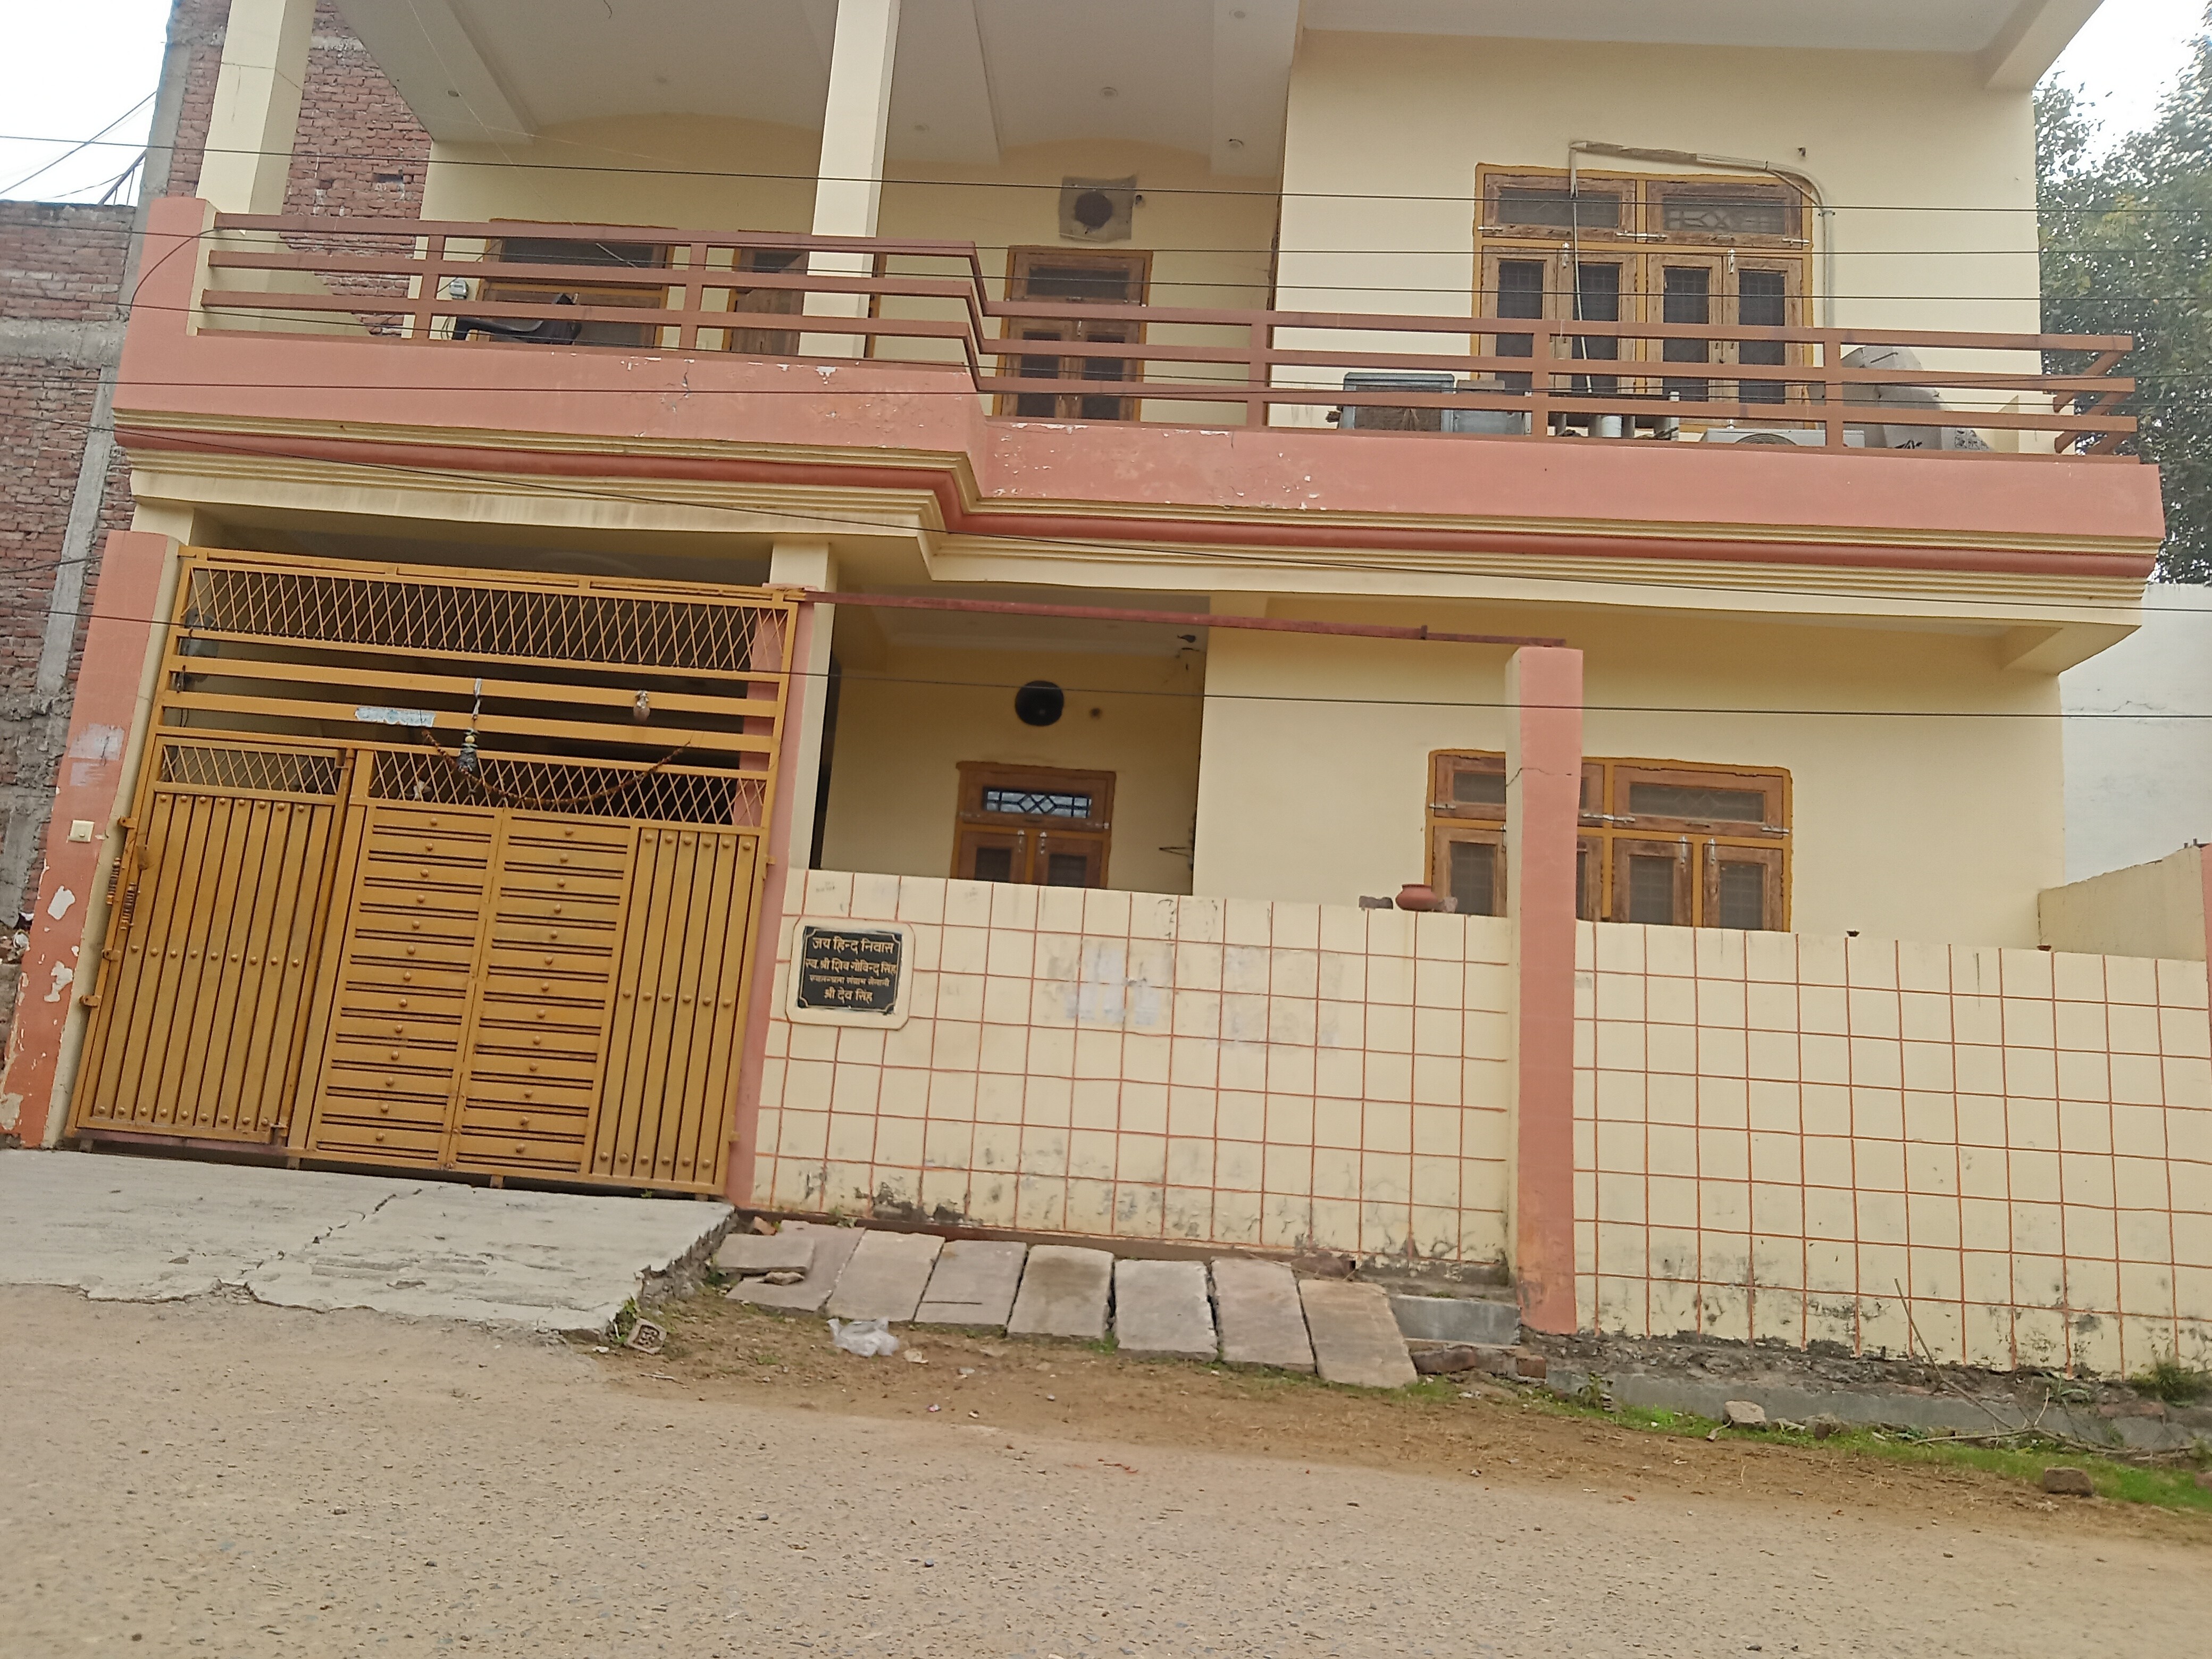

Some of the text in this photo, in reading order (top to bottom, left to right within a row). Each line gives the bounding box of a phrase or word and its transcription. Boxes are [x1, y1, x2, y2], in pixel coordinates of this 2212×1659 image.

[812, 936, 894, 955] जय हिन्द निवास
[820, 958, 830, 969] श्री
[832, 958, 850, 973] शिव
[851, 959, 880, 976] गोविन्द
[881, 961, 897, 976] सिंह
[825, 986, 873, 1004] श्री देव सिंह
